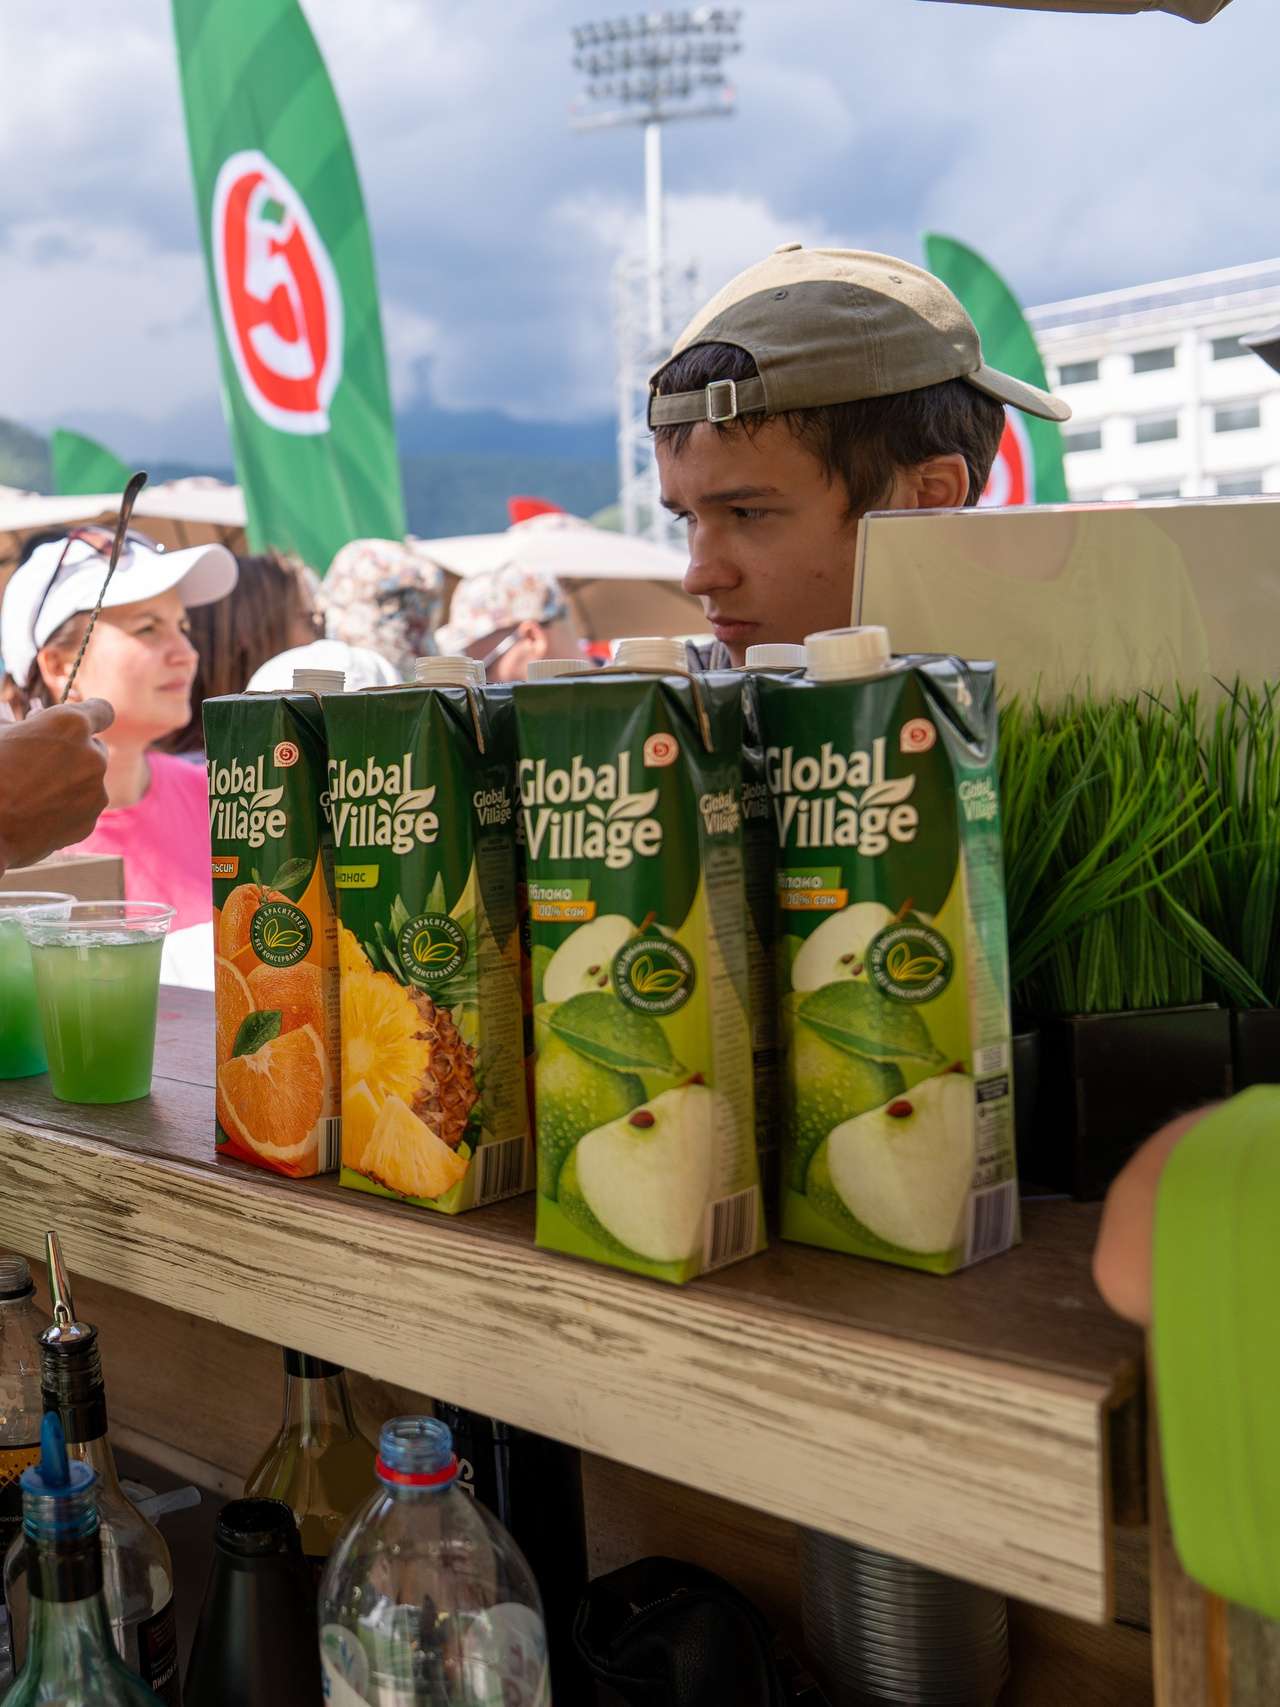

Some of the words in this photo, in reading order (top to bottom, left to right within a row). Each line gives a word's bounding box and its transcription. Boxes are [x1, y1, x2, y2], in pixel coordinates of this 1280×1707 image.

[327, 752, 413, 802] Global
[766, 736, 887, 795] Global
[519, 750, 631, 807] Global
[741, 781, 767, 800] Globa
[473, 786, 507, 809] Global
[476, 805, 512, 827] Village
[773, 795, 919, 857] Village
[330, 802, 439, 855] Village
[523, 807, 663, 870] Village
[211, 862, 234, 873] льсин
[263, 907, 307, 930] КРАСИТЕЛЕЙ
[413, 918, 462, 942] КРАСИТЕЛЕЙ
[262, 941, 306, 962] КОНСЕРВАНТОВ
[412, 955, 462, 979] КОНСЕРВАНТОВ
